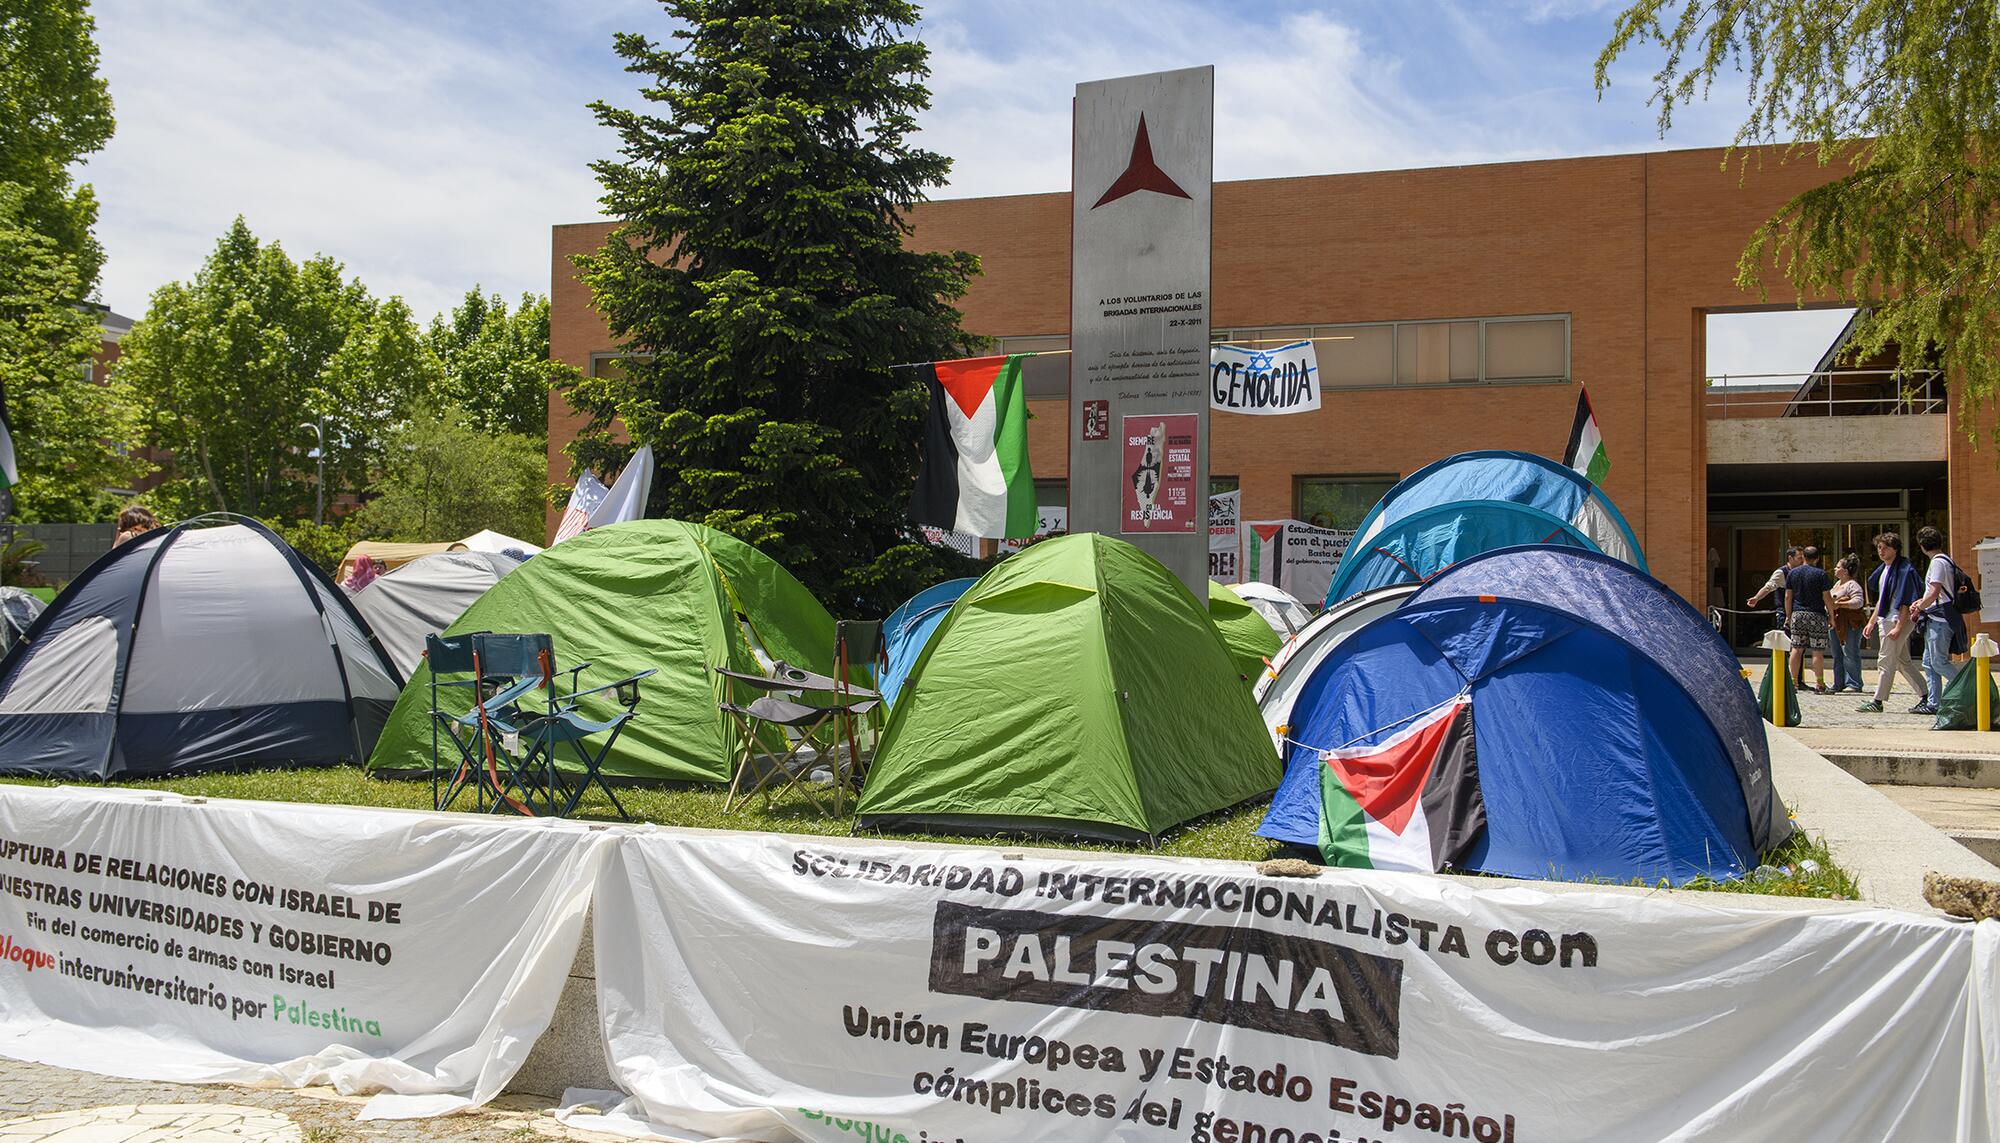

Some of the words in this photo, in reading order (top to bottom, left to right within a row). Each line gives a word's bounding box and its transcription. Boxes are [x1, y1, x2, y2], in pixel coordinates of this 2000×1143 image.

[1123, 293, 1173, 303] VOLUNTARIOS
[1175, 292, 1185, 300] DE
[1187, 291, 1202, 299] LAS
[1103, 308, 1138, 317] BRIGADAS
[1139, 303, 1202, 315] INTERNACIONALES
[1169, 318, 1202, 327] 22-X-2011
[1212, 358, 1313, 408] GENOCIDA
[1128, 436, 1155, 446] SIEMPRE
[1168, 453, 1191, 462] ESTATAL
[1130, 509, 1173, 521] RESISTENCIA
[1208, 527, 1236, 535] DEBER
[1287, 524, 1336, 536] Estudiantes
[1287, 537, 1308, 546] con
[1310, 536, 1320, 547] el
[1308, 549, 1331, 557] Basta
[0, 838, 67, 870] UPTURA
[73, 852, 102, 875] DE
[105, 857, 227, 898] RELACIONES
[232, 878, 274, 906] CON
[280, 887, 361, 921] ISRAEL
[367, 900, 402, 925] DE
[791, 848, 1024, 898] SOLIDARIDAD
[1034, 871, 1471, 960] INTERNACIONALISTA
[1484, 927, 1599, 969] con
[88, 892, 244, 940] UNIVERSIDADES
[250, 920, 264, 943] Y
[268, 925, 393, 966] GOBIERNO
[26, 911, 47, 932] Fin
[51, 917, 77, 938] del
[80, 925, 160, 955] comercio
[164, 938, 184, 959] de
[188, 945, 238, 971] armas
[242, 957, 274, 980] con
[279, 962, 335, 990] Israel
[961, 925, 1347, 1024] PALESTINA
[59, 951, 227, 1011] interuniversitario
[232, 996, 268, 1022] por
[273, 993, 383, 1038] Palestina
[842, 1004, 949, 1050] Unión
[959, 1021, 1128, 1073] Europea
[1138, 1046, 1166, 1083] y
[1167, 1046, 1313, 1103] Estado
[1328, 1076, 1516, 1143] Español
[912, 1066, 1118, 1120] cómplices
